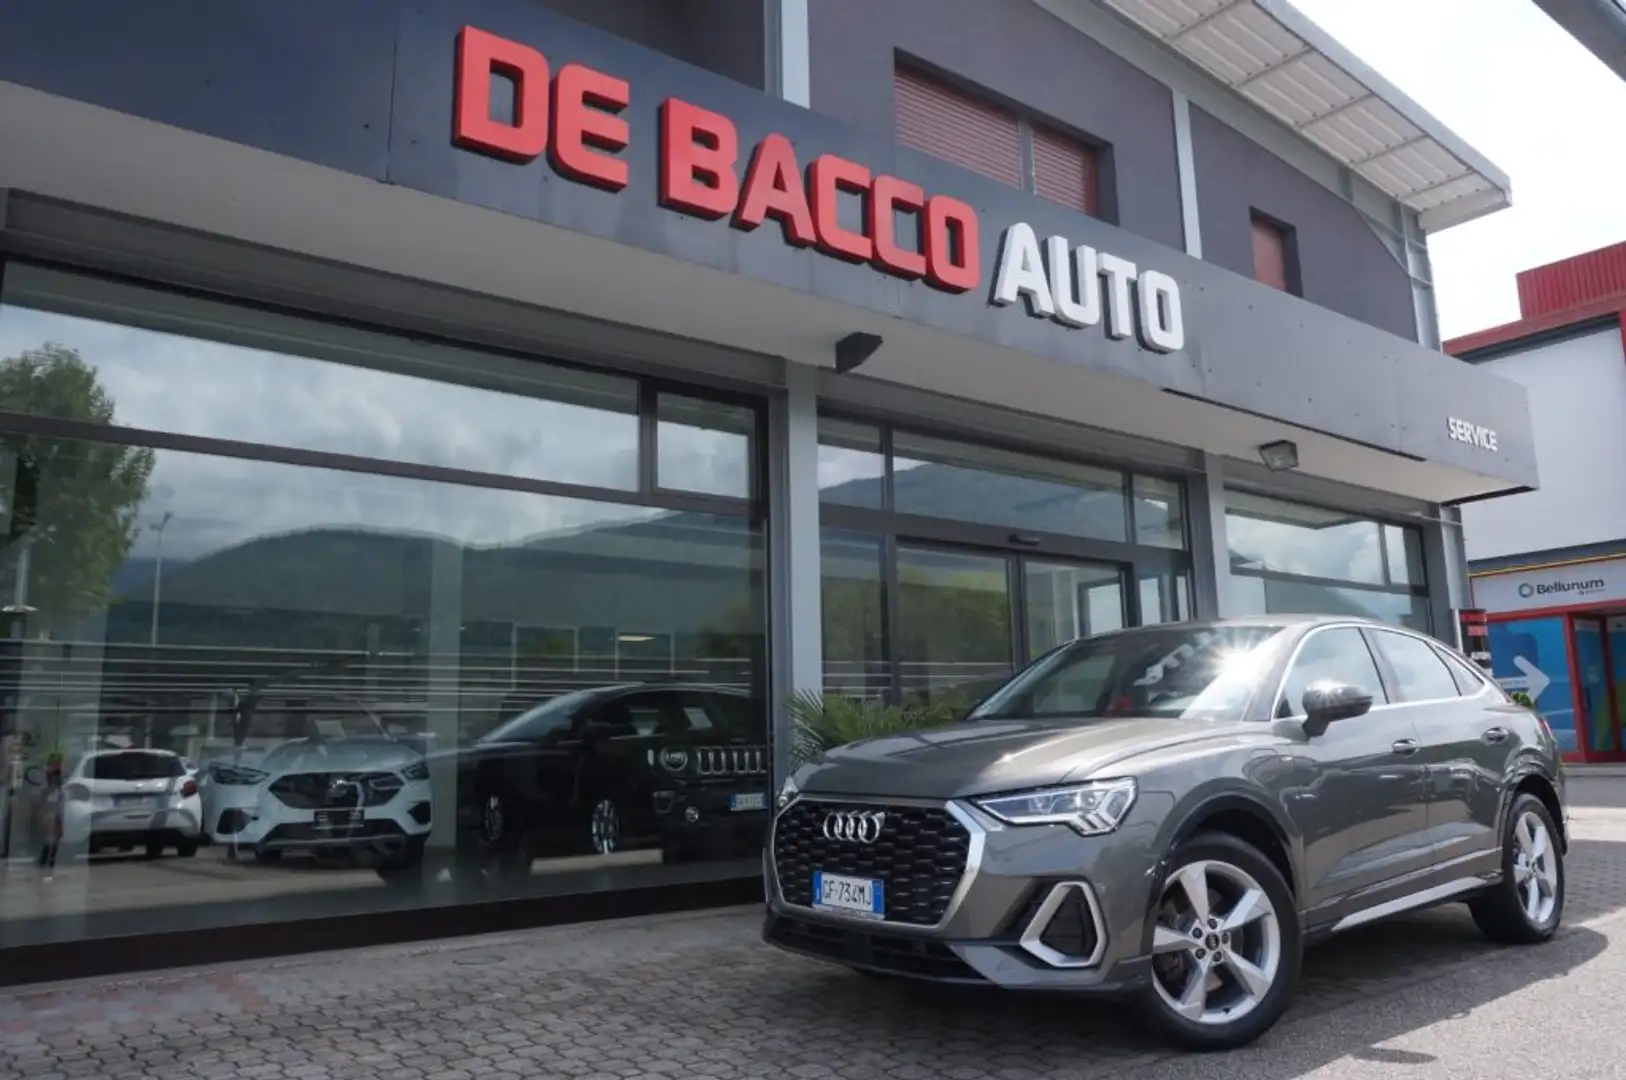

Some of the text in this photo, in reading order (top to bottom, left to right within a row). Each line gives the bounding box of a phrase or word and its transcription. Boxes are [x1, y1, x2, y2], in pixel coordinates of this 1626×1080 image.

[453, 24, 1185, 354] DE BACCO AUTO
[1446, 416, 1499, 453] SERVICE
[1536, 577, 1605, 595] Bellunum
